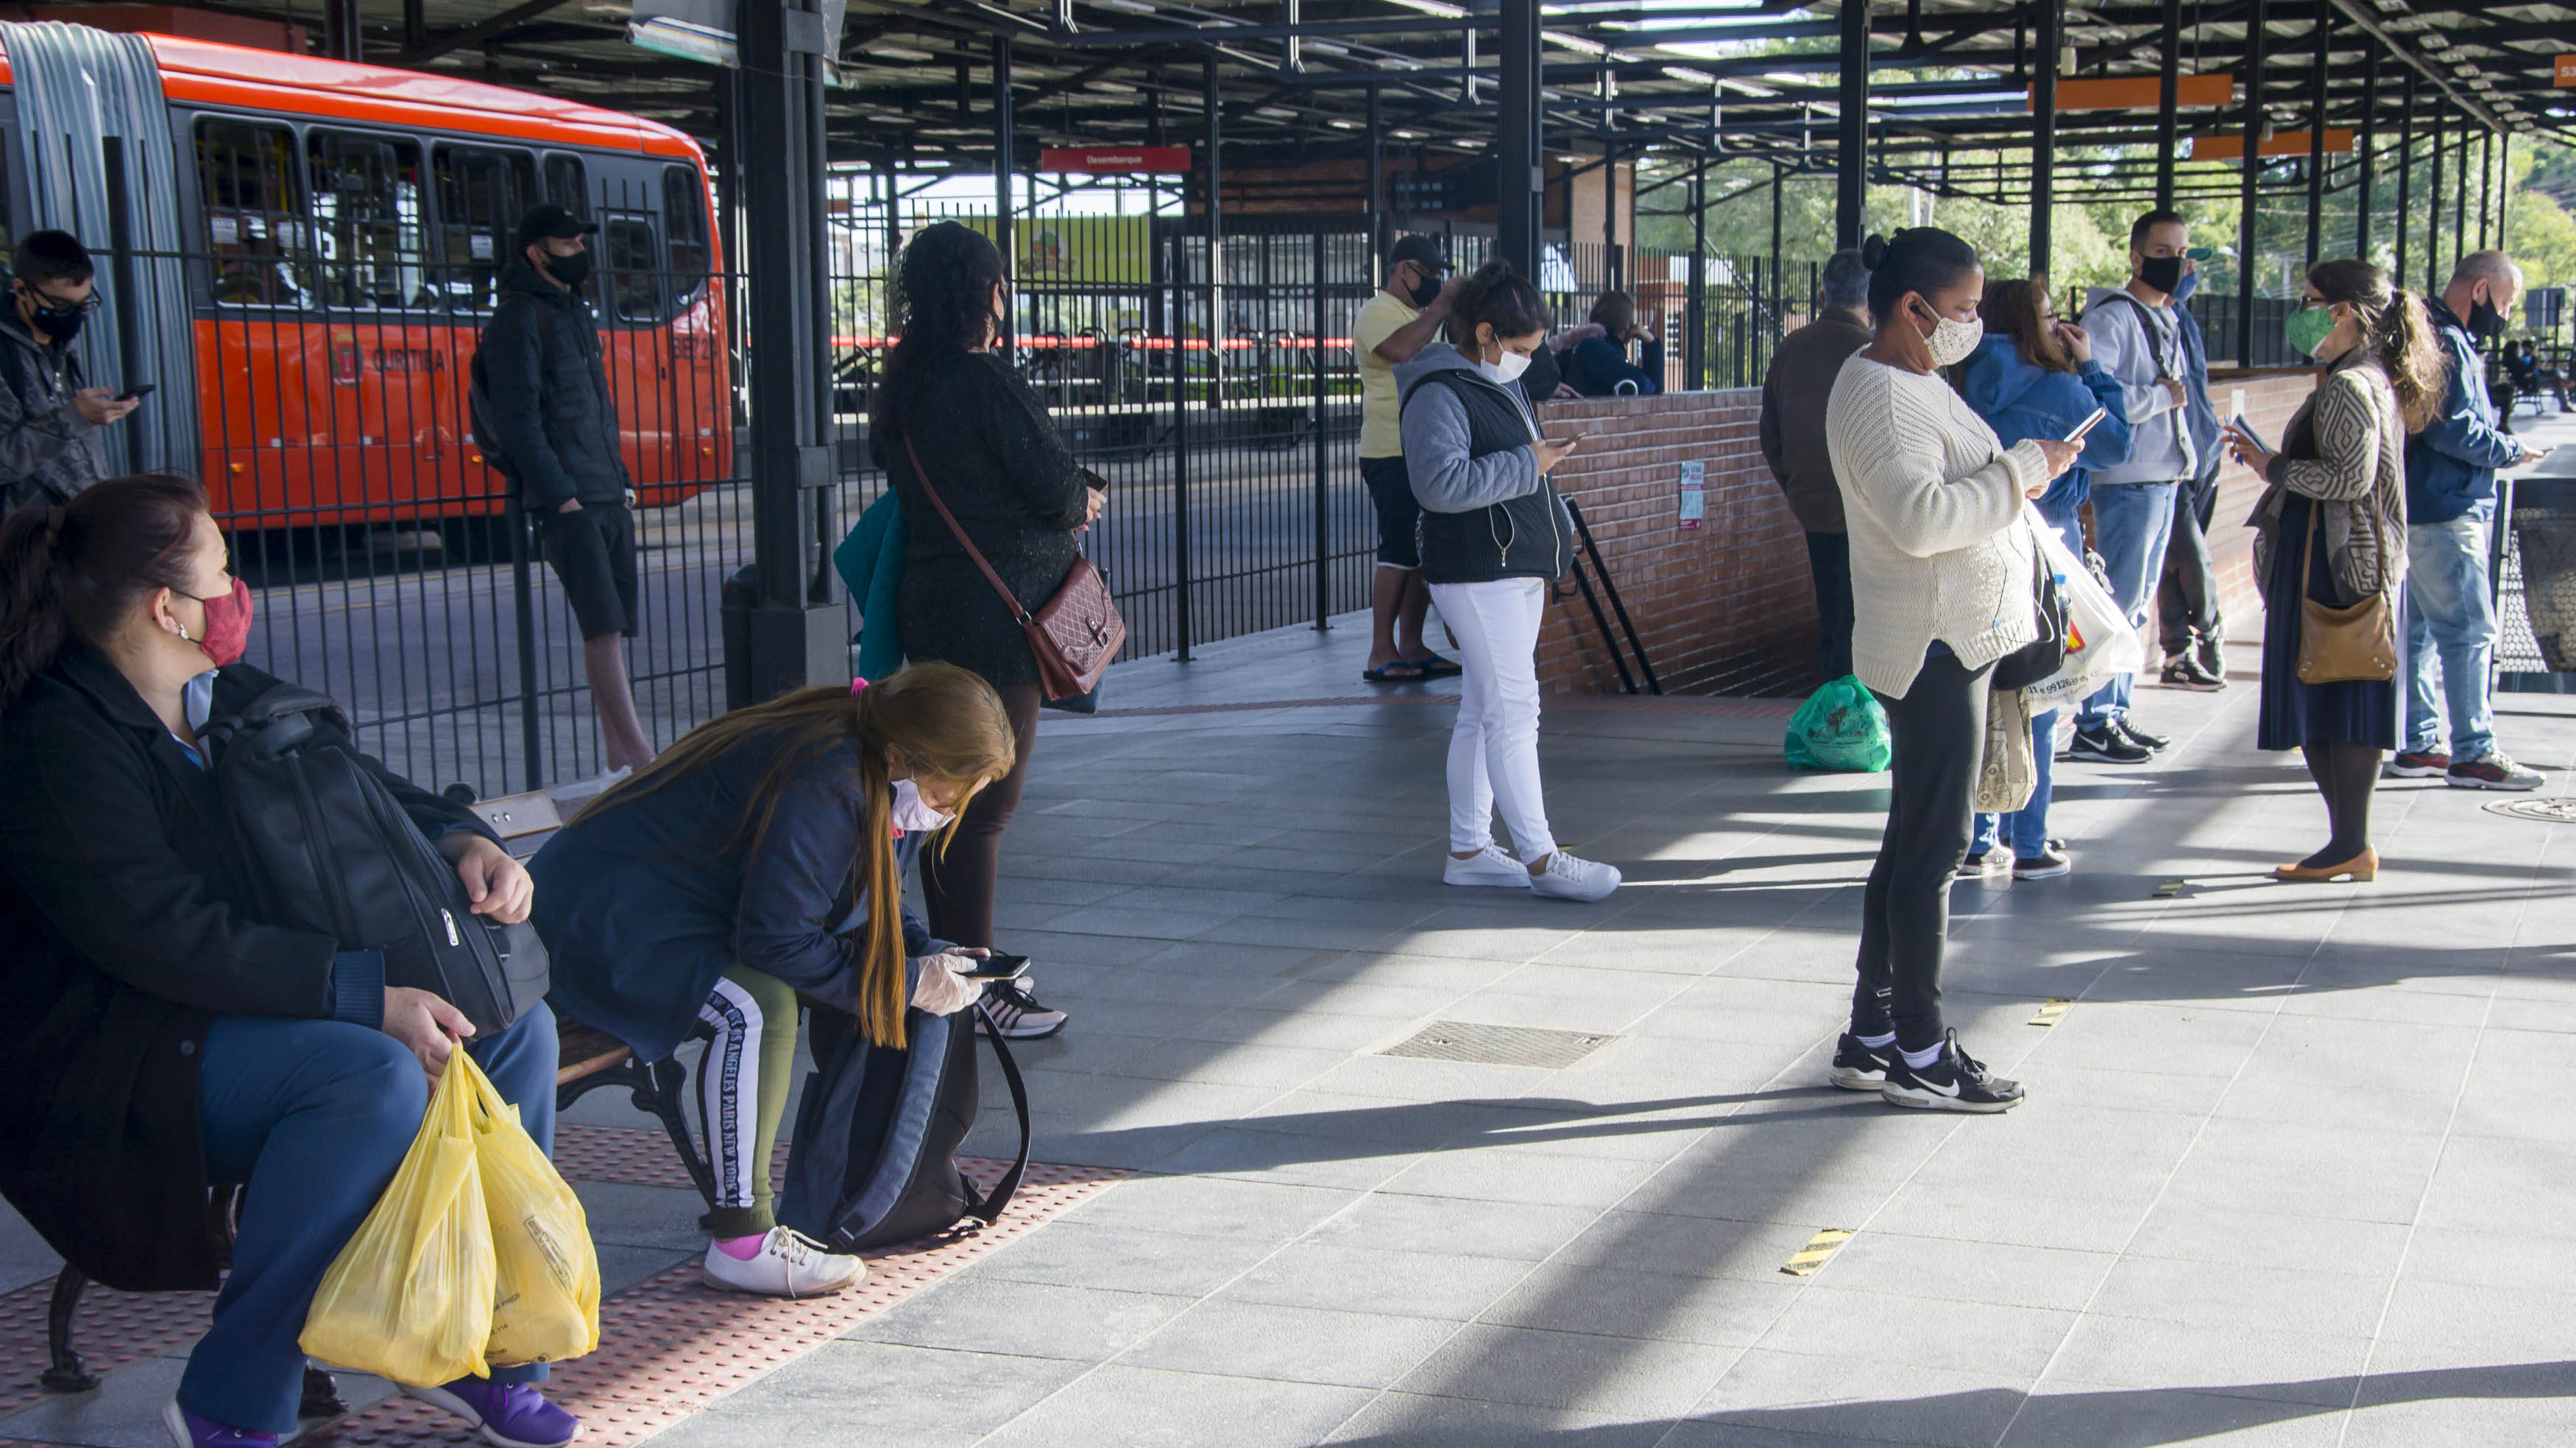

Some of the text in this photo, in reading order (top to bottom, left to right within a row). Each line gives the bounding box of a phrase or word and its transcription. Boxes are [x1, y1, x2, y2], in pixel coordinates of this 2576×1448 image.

[1087, 155, 1142, 165] Desembarque
[372, 348, 447, 372] CURITIBA
[724, 1043, 741, 1092] ANGELES
[722, 1094, 736, 1129] PARIS
[723, 1131, 737, 1156] NEW
[724, 1159, 738, 1191] YORK
